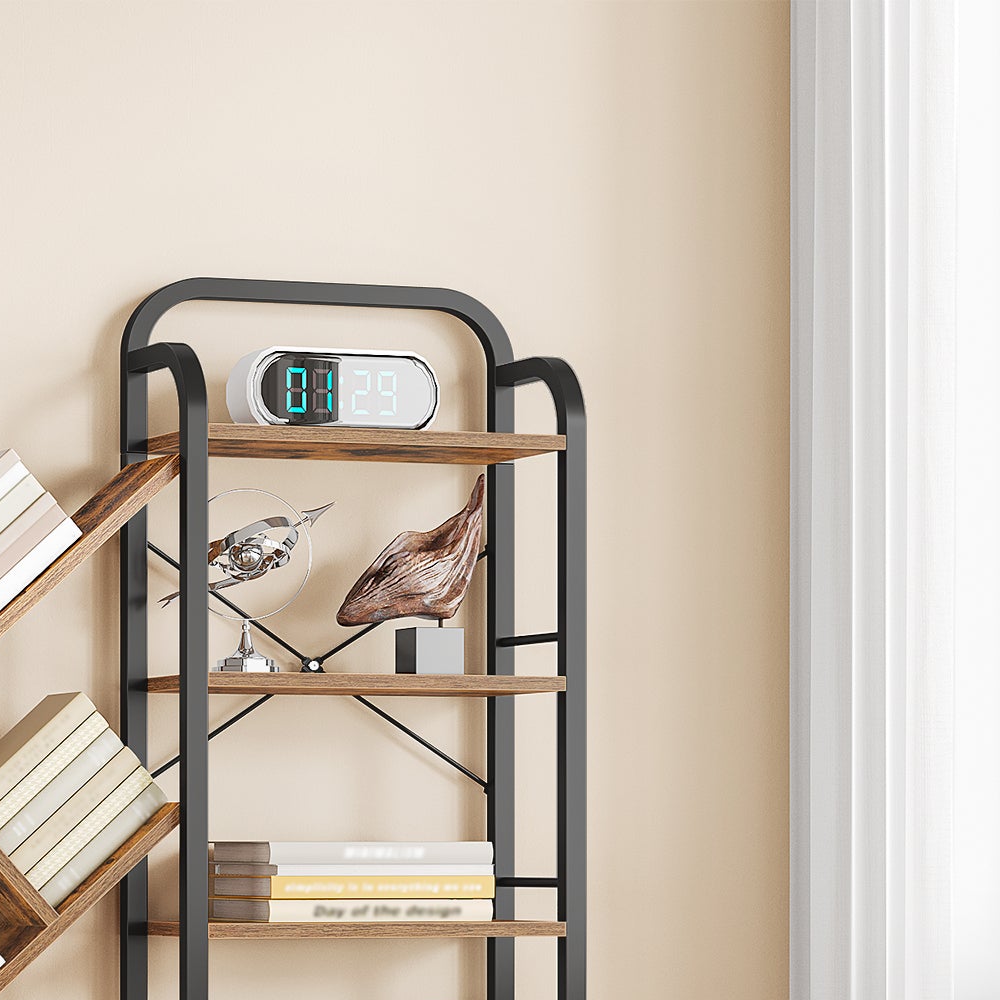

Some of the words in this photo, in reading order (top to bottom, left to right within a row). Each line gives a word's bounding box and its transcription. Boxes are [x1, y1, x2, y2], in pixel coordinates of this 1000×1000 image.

[314, 905, 344, 918] Day
[351, 905, 369, 917] of
[374, 905, 400, 917] the
[406, 905, 461, 918] design
